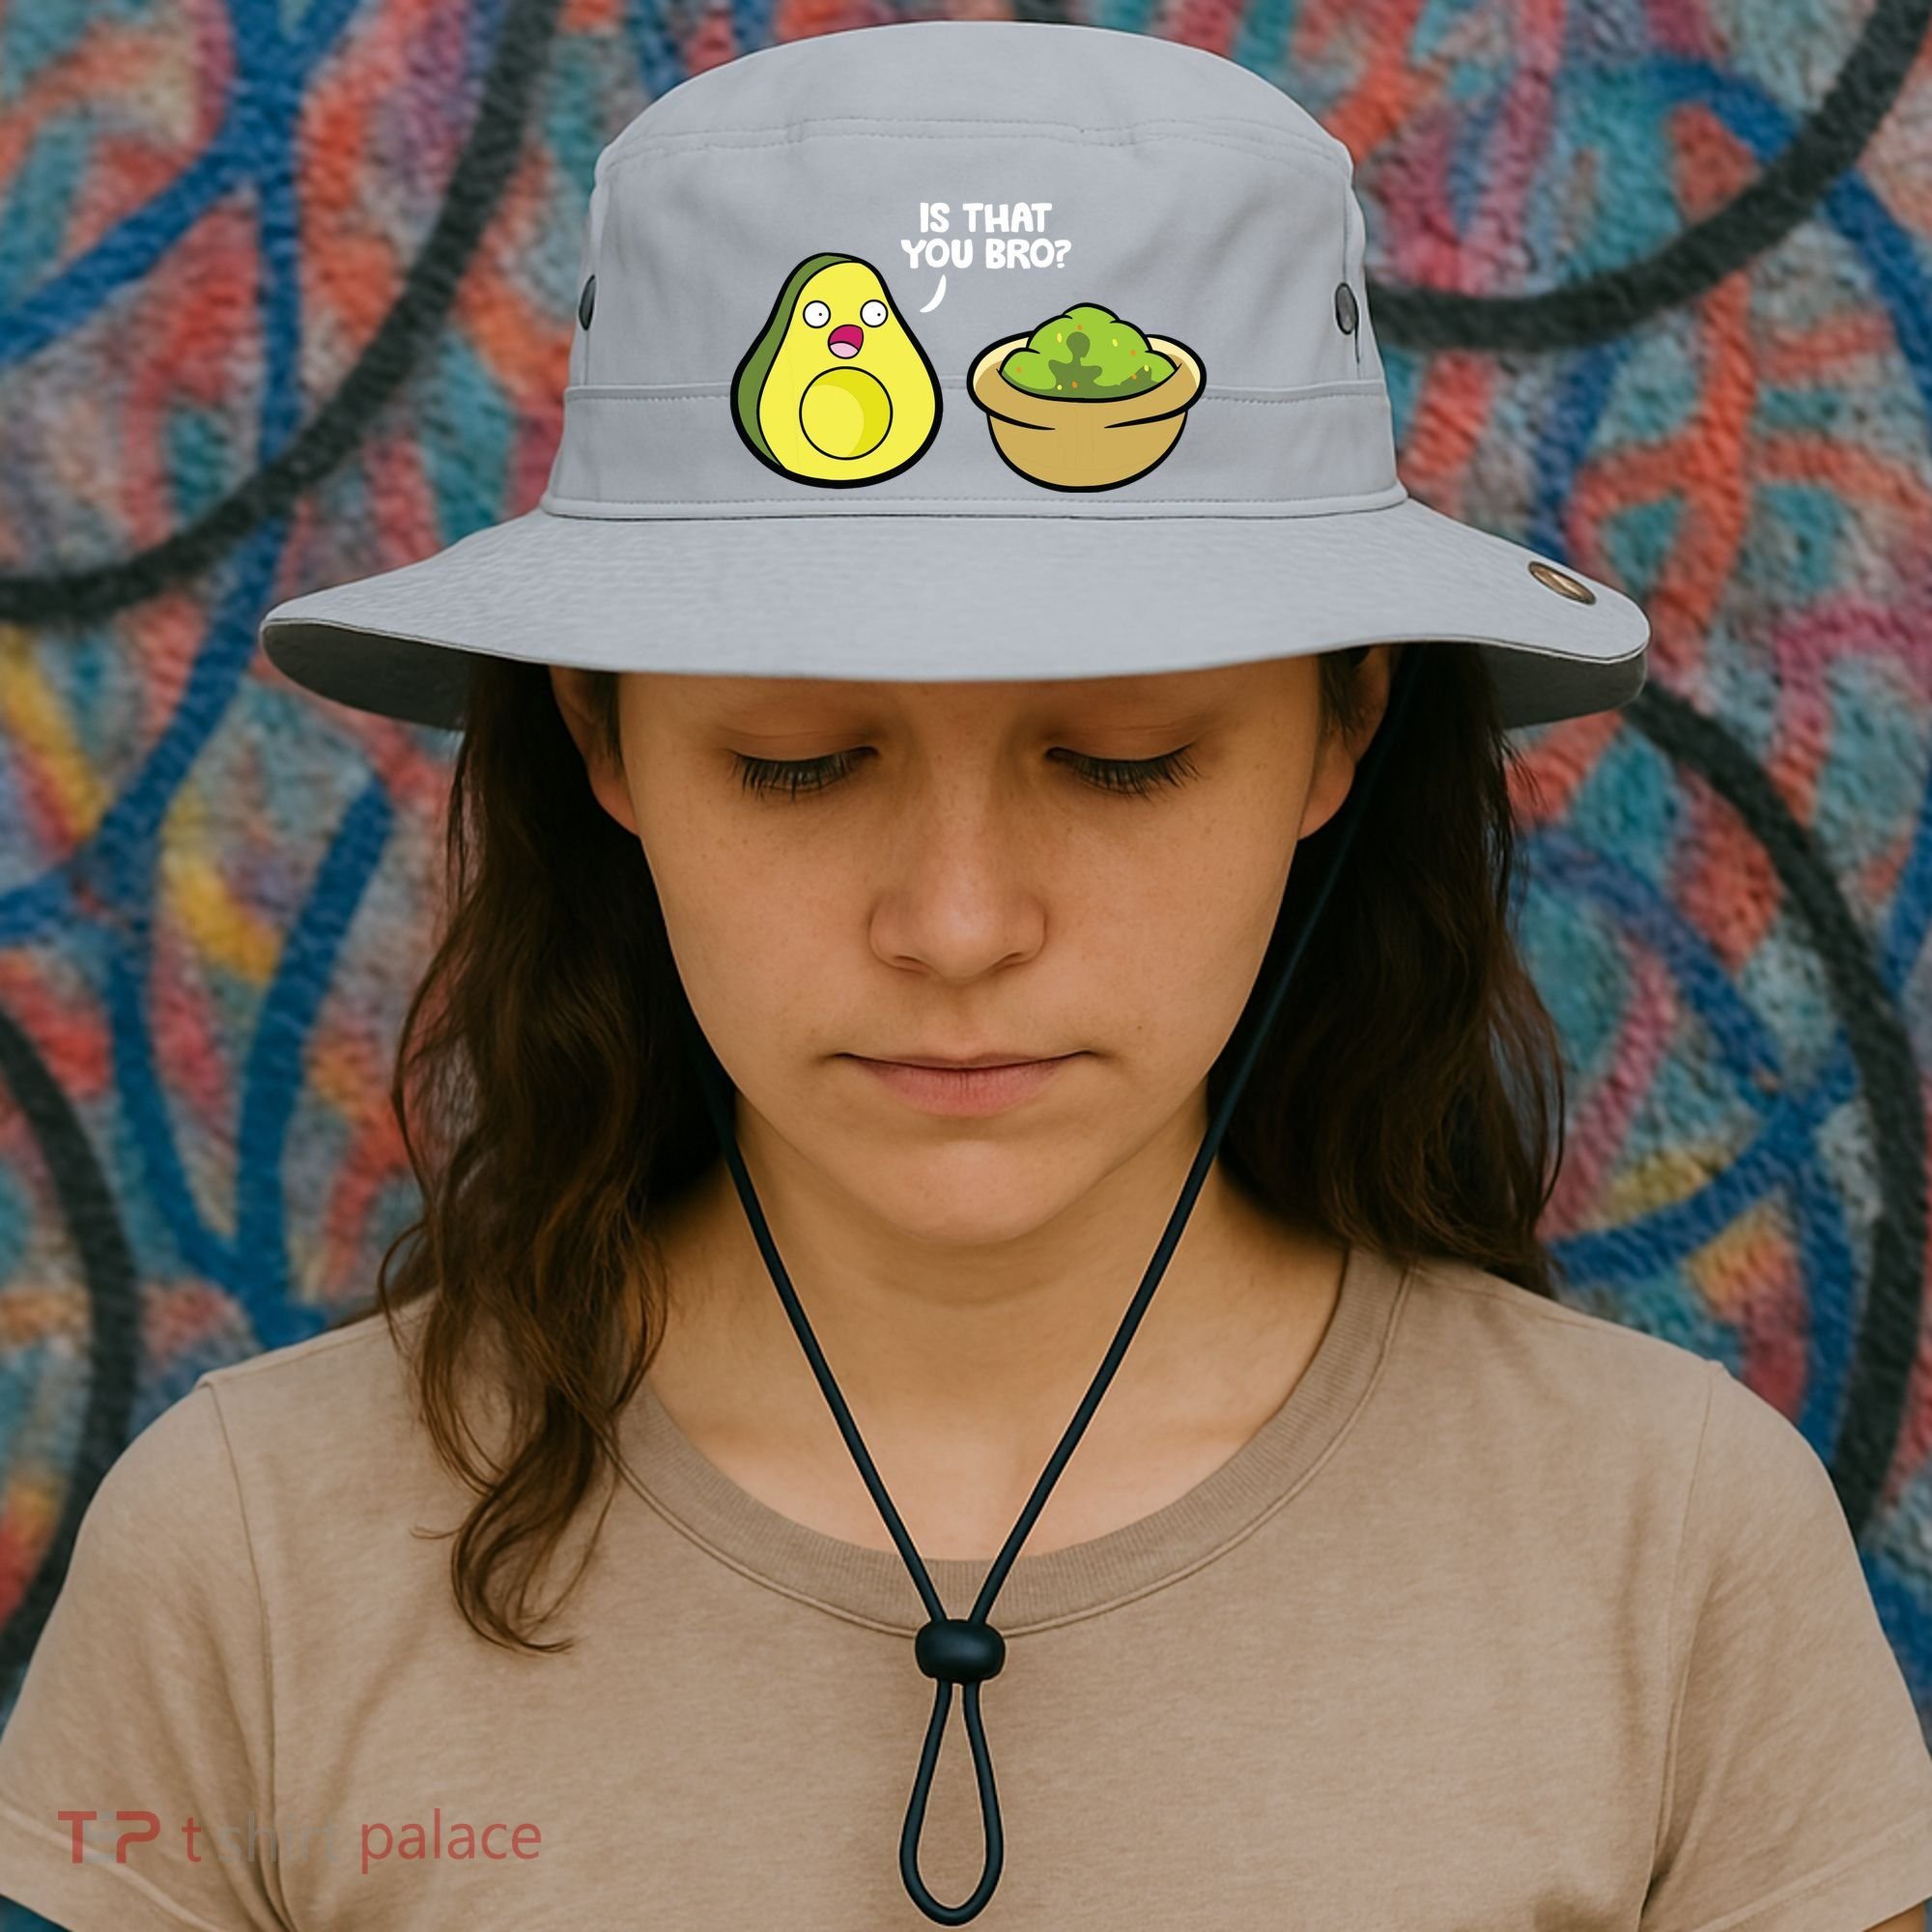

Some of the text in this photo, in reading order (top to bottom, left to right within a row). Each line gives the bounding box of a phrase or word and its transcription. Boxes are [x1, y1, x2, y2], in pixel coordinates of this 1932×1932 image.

[920, 202, 1052, 233] IS THAT
[900, 238, 1072, 270] YOU BRO?
